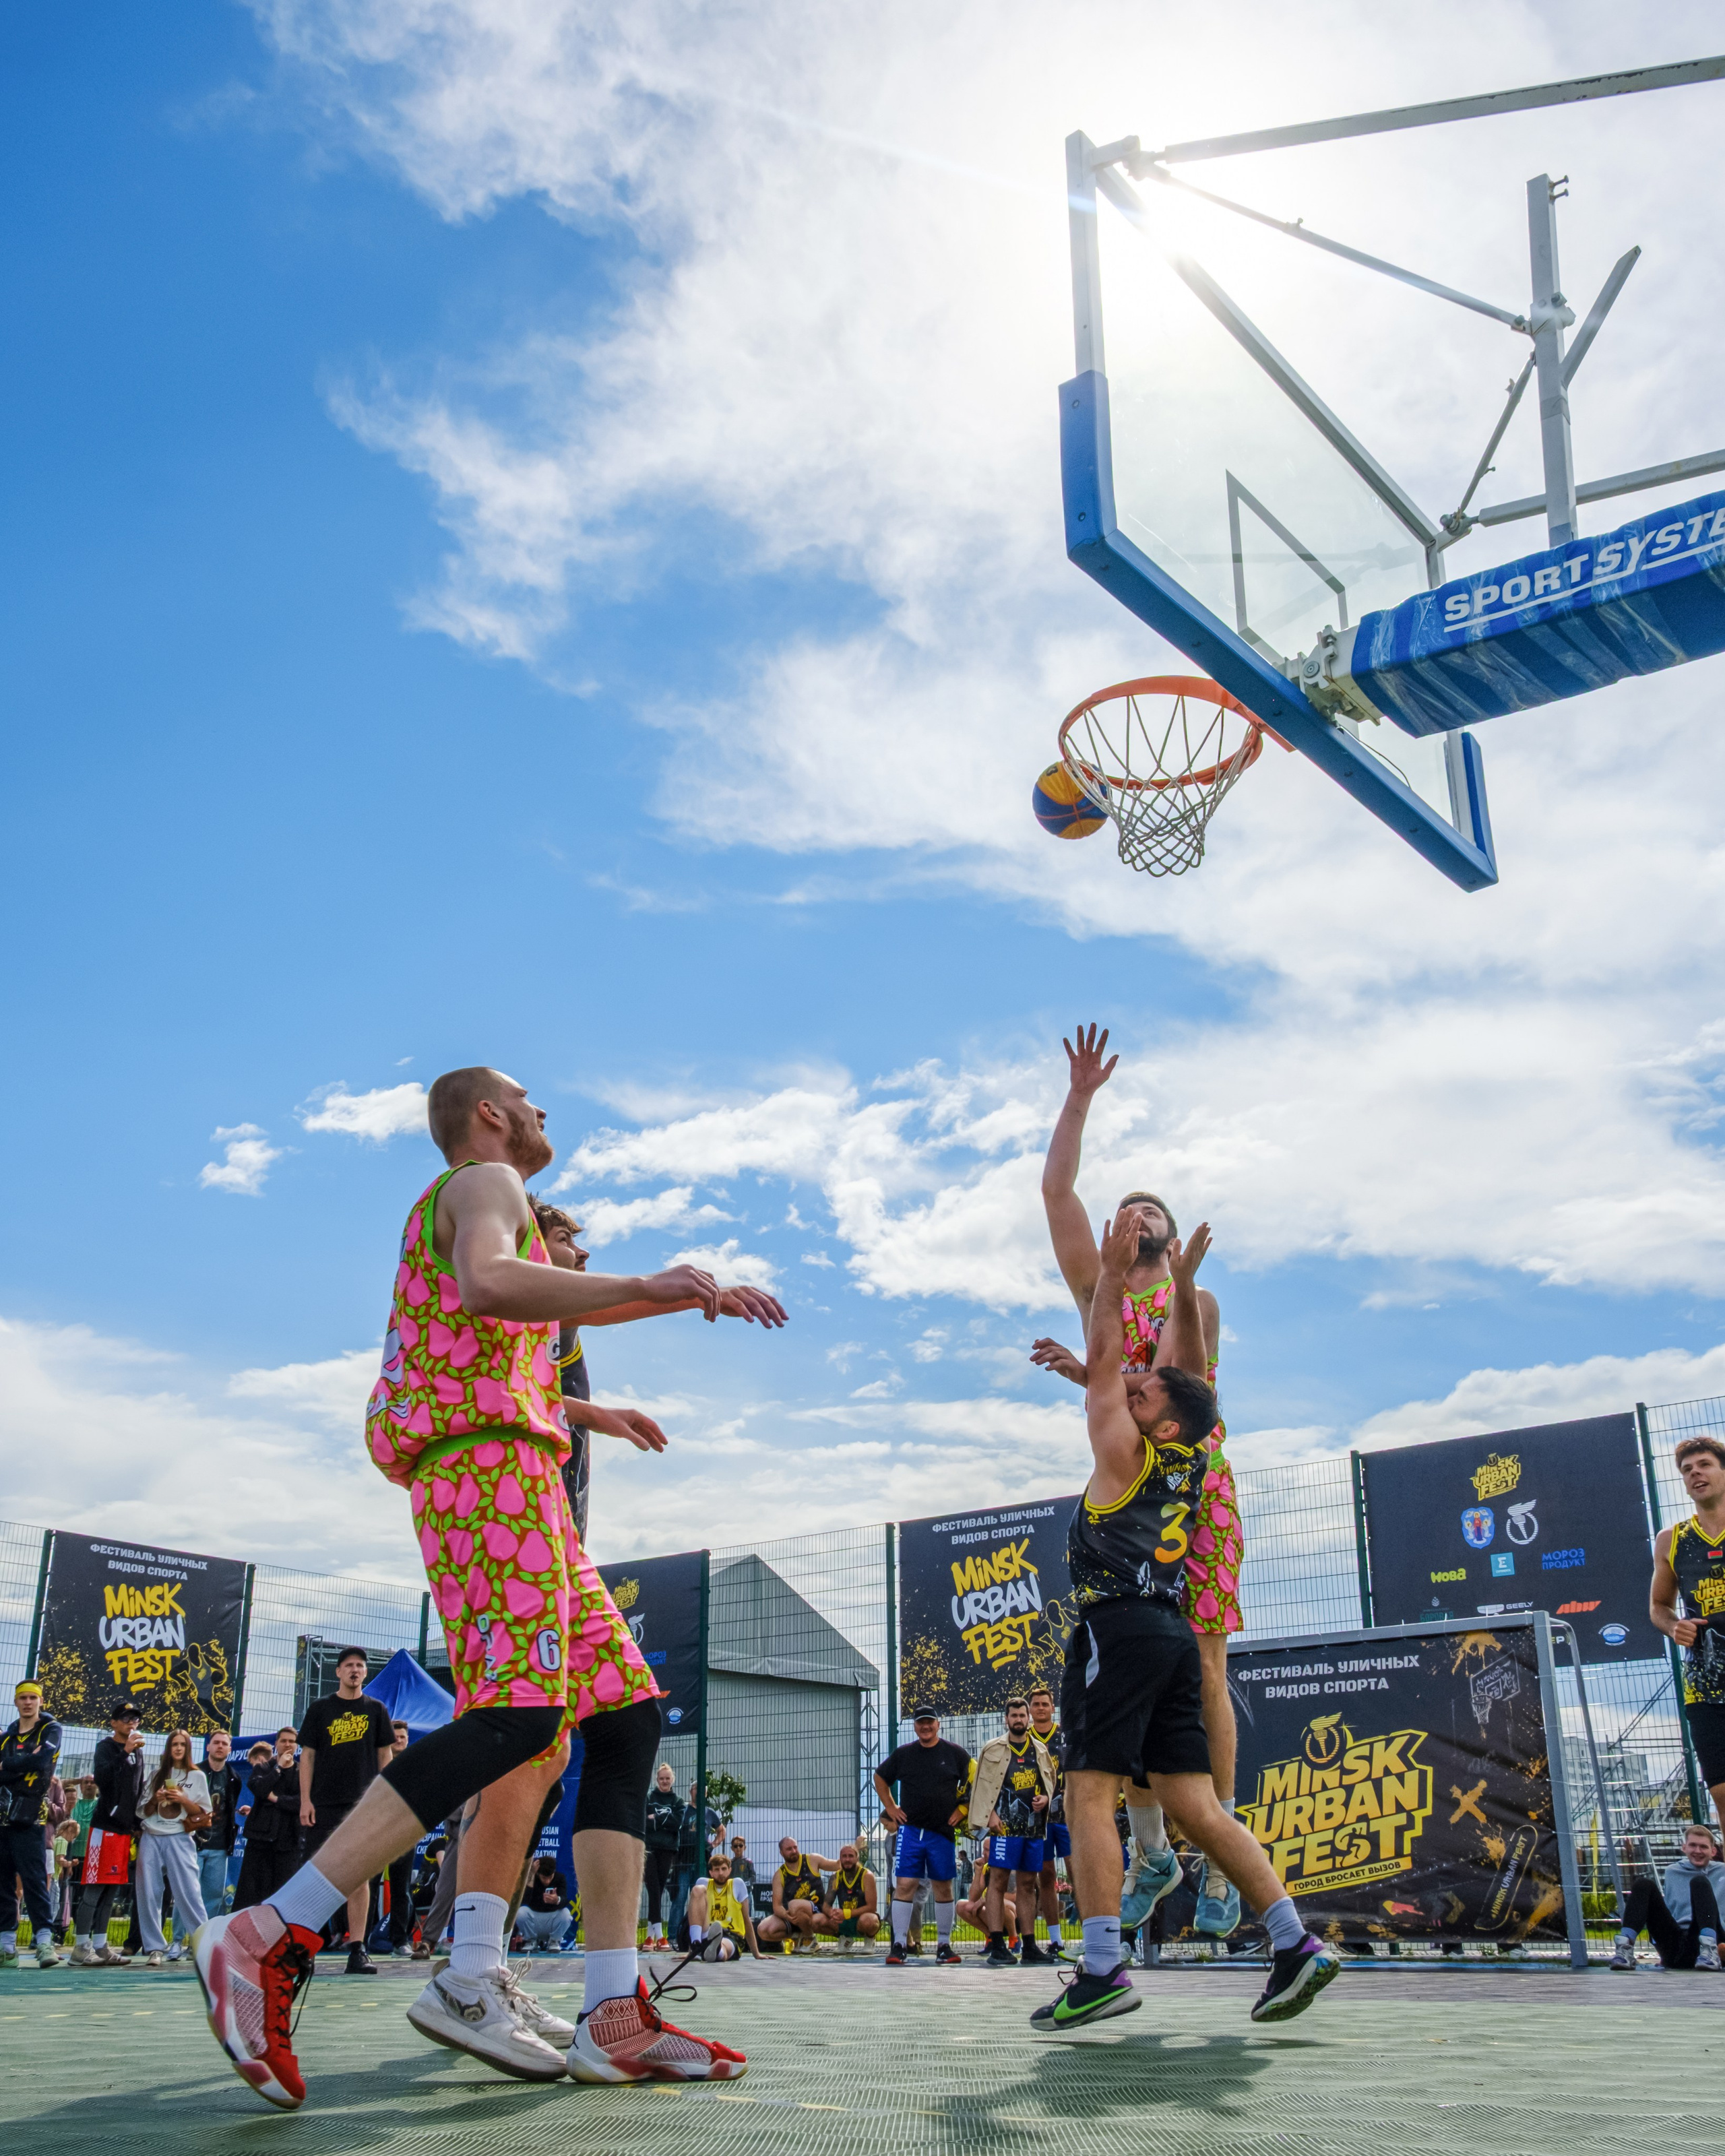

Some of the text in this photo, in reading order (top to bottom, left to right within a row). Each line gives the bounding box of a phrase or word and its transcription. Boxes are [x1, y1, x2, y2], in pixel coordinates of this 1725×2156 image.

[1444, 507, 1725, 621] SPORT SYSTE
[1475, 1464, 1517, 1486] URBAN
[1476, 1456, 1515, 1476] MINSK
[1481, 1475, 1515, 1498] FEST
[932, 1506, 1055, 1533] ФЕСТИВАЛЬ УЛИЧНЫХ
[951, 1524, 1035, 1545] ВИДОВ СПОРТА
[1154, 1502, 1191, 1563] 3
[90, 1544, 208, 1571] ФЕСТИВАЛЬ УЛИЧНЫХ
[1542, 1548, 1585, 1561] МОРОЗ
[1542, 1558, 1586, 1571] ПРОДУКТ
[108, 1560, 188, 1581] ВИДОВ СПОРТА
[1697, 1584, 1725, 1602] URB
[1698, 1576, 1725, 1591] MIN
[951, 1572, 1042, 1630] URBAN
[1506, 1601, 1534, 1610] GEELY
[99, 1614, 185, 1653] URBAN
[962, 1612, 1039, 1665] FEST
[537, 1628, 561, 1671] 6
[105, 1647, 181, 1685] FEST
[1238, 1655, 1420, 1682] ФЕСТИВАЛЬ УЛИЧНЫХ
[1265, 1678, 1389, 1699] ВИДОВ СПОРТА
[331, 1721, 366, 1734] URBAN
[334, 1728, 363, 1743] FEST
[1262, 1735, 1410, 1806] MINSK
[1248, 1769, 1419, 1845] URBAN
[542, 1826, 559, 1835] USIAN
[1269, 1812, 1407, 1885] FEST
[1294, 1861, 1401, 1891] ГОРОД БРОСАЕТ ВЫЗОВ
